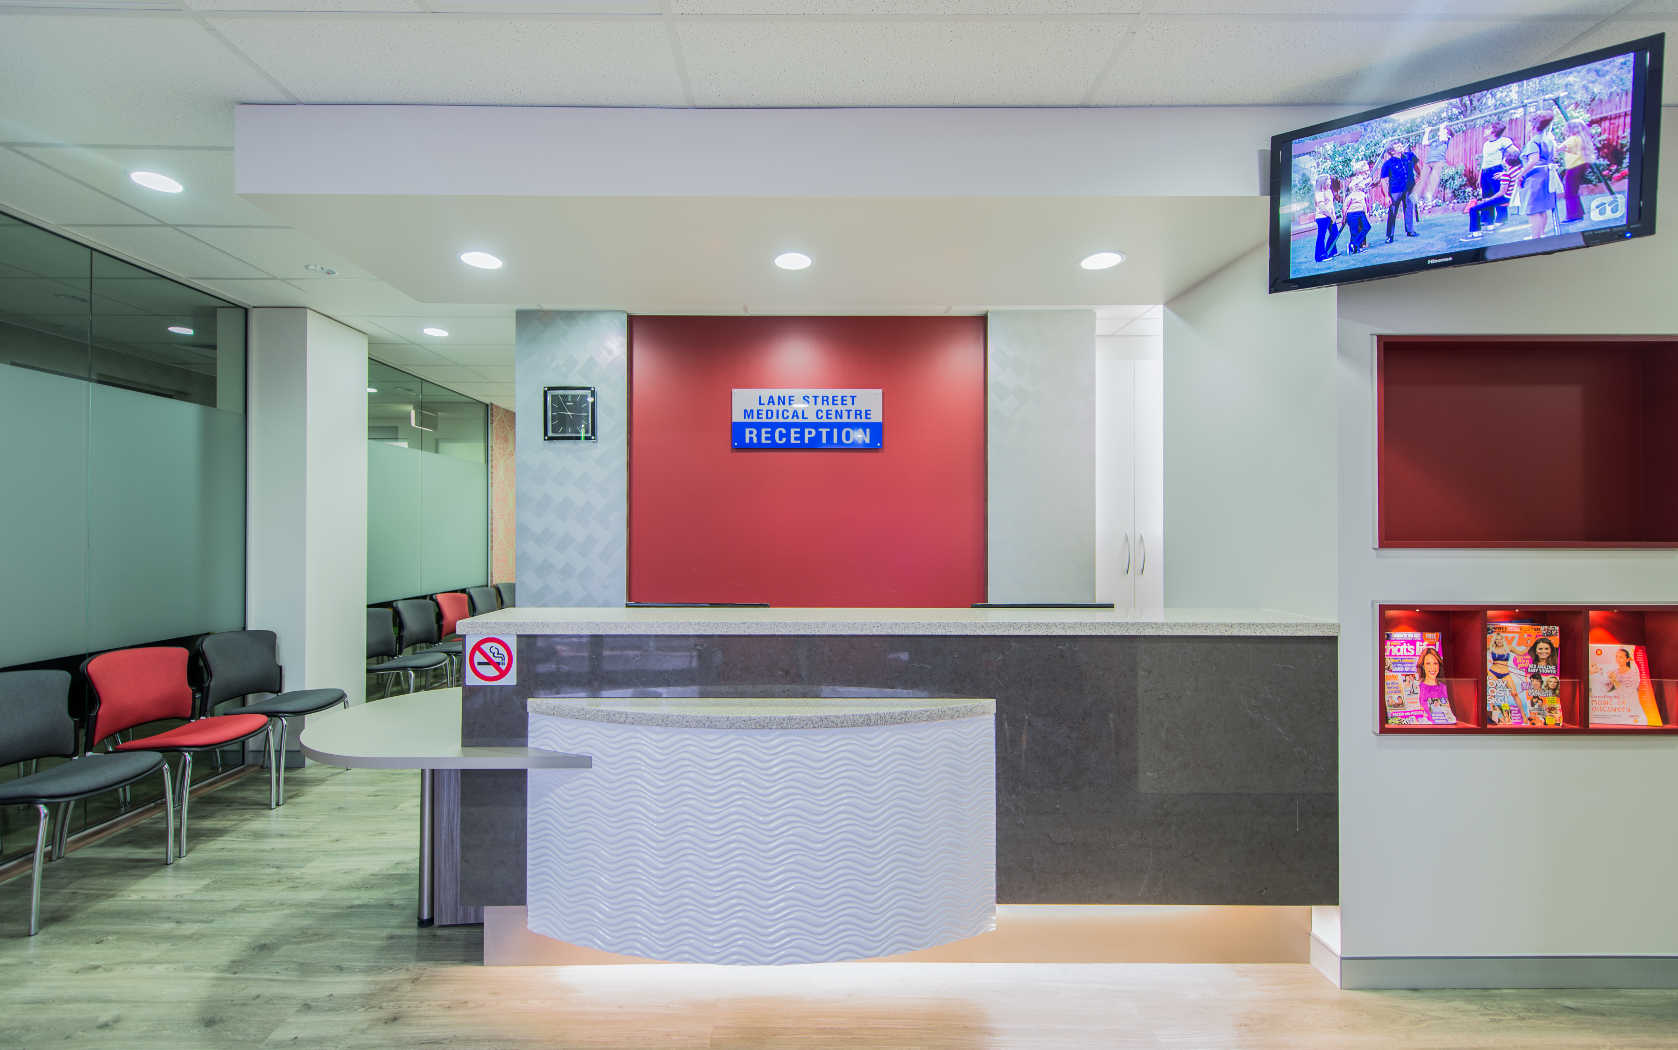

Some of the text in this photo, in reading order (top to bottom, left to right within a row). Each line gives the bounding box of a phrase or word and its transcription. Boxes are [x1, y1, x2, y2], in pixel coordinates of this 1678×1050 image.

[758, 395, 857, 406] LANE STREET
[743, 409, 872, 420] MEDICAL CENTRE
[744, 427, 871, 444] RECEPTION
[1385, 641, 1415, 656] hat's
